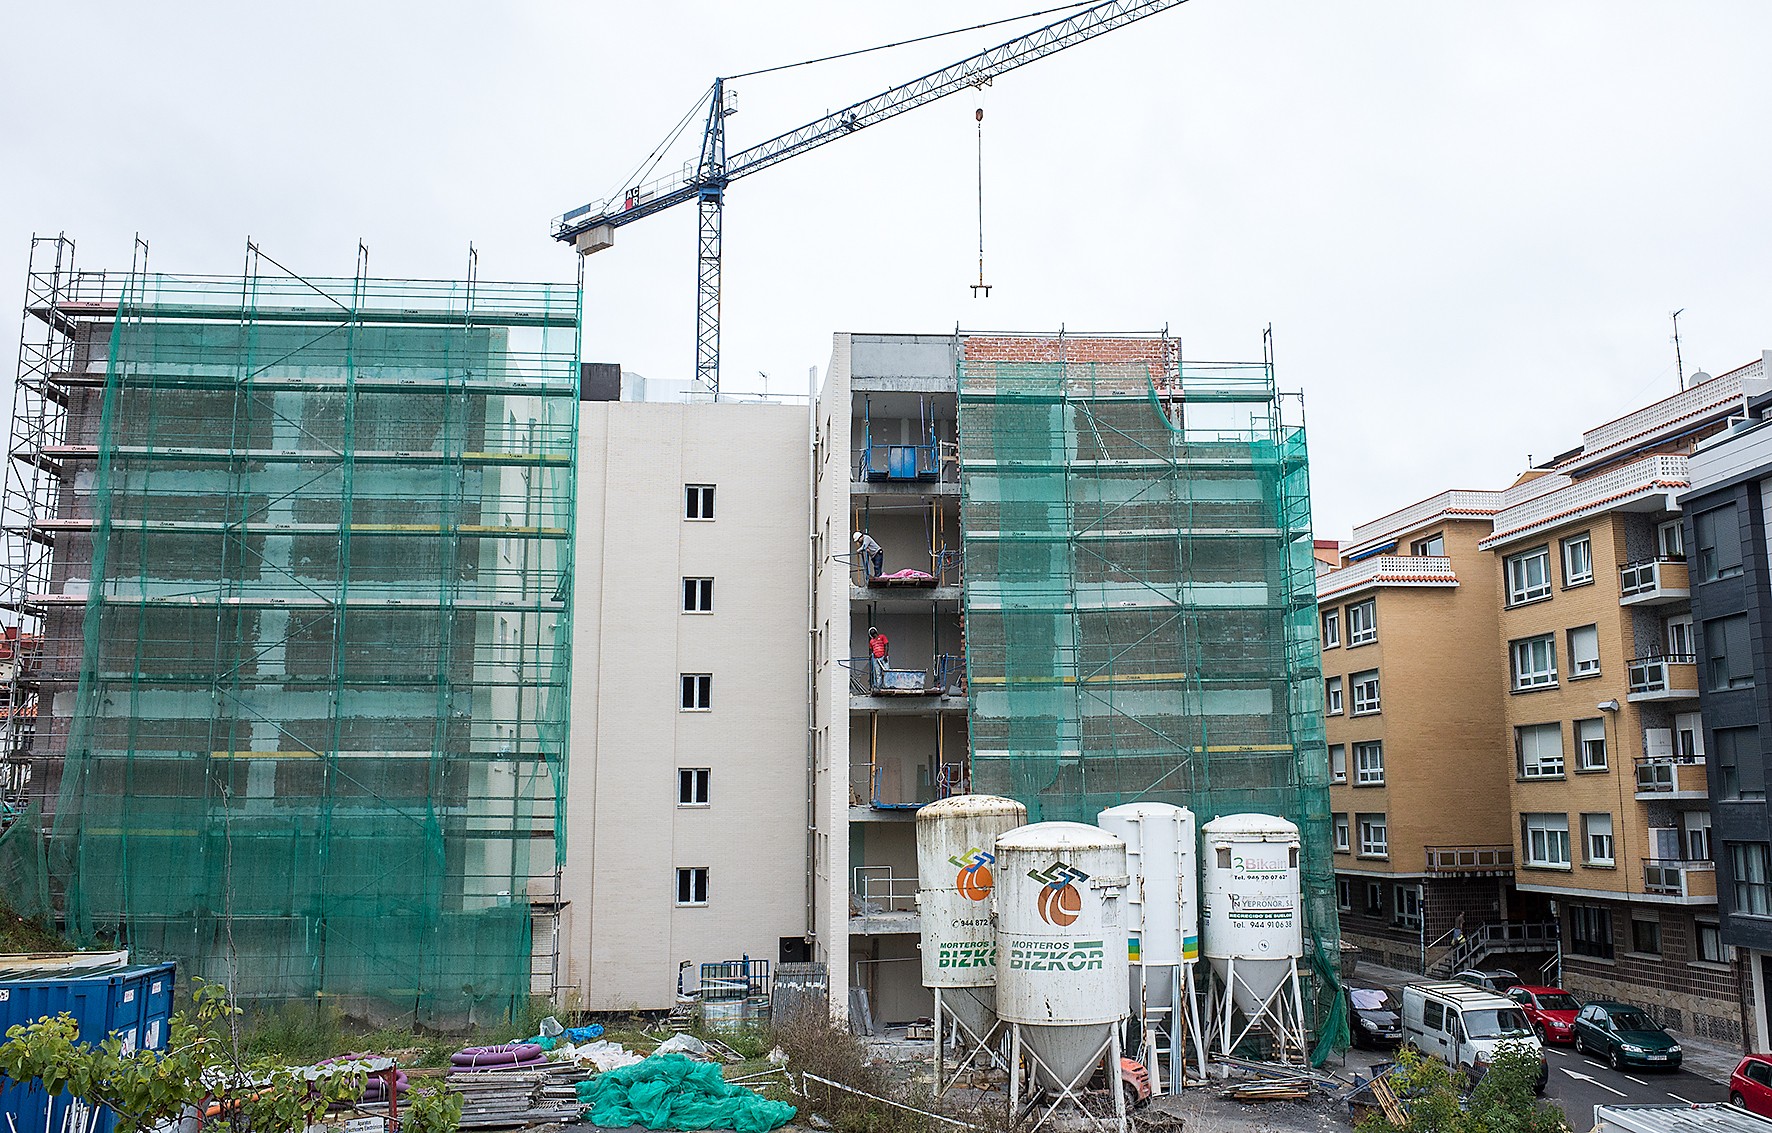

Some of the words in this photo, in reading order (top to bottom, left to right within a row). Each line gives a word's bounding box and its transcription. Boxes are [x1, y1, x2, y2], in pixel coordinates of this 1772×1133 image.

[940, 941, 990, 949] MORTEROS
[1012, 941, 1070, 950] MORTEROS
[1009, 949, 1104, 972] BIZKOR
